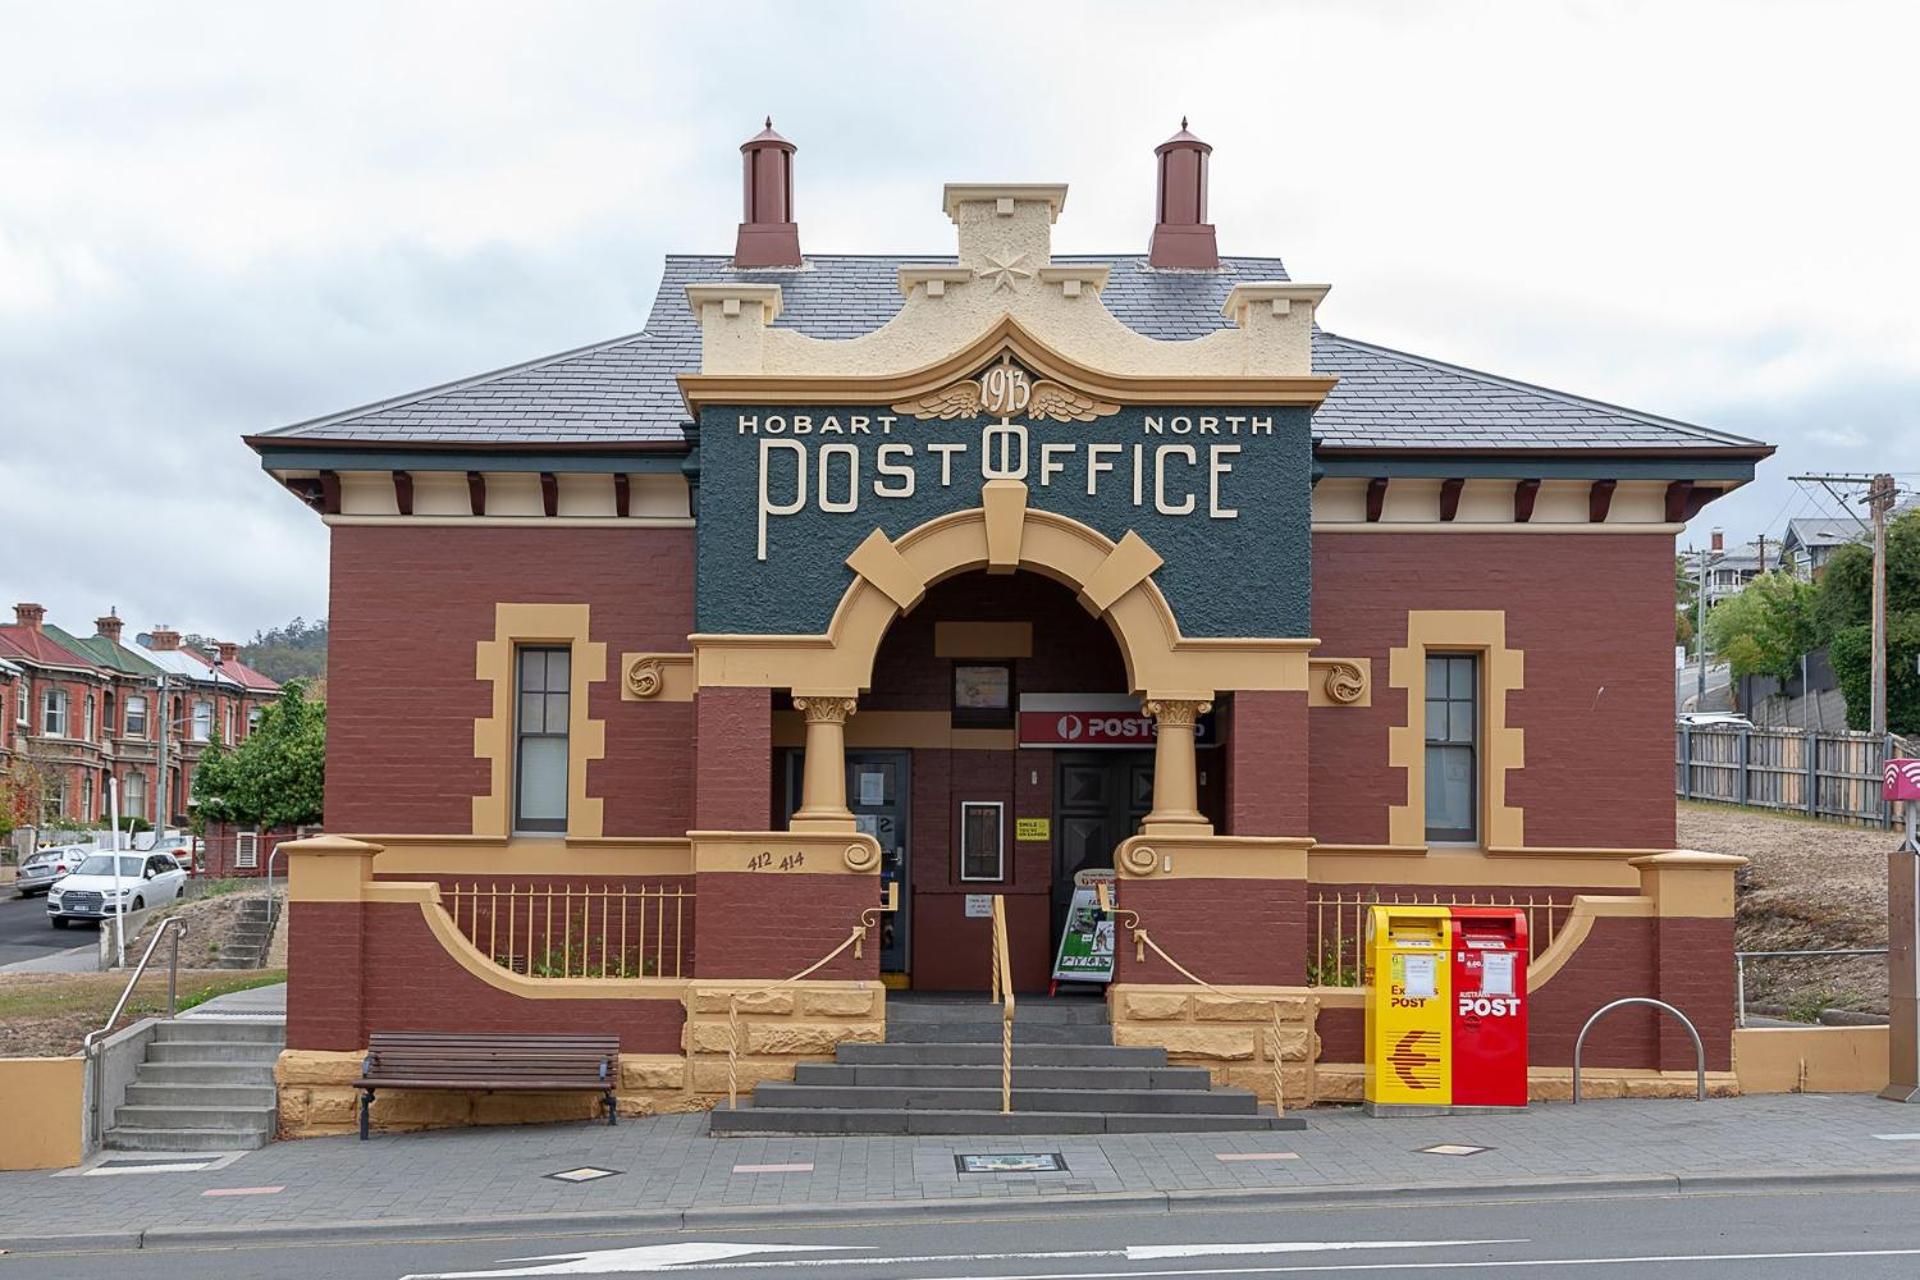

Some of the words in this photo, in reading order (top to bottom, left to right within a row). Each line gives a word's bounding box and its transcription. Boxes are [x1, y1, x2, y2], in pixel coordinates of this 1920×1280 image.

[980, 368, 1030, 412] 1913
[738, 415, 897, 435] HOBART
[1145, 416, 1273, 435] NORTH
[757, 438, 968, 561] POST
[981, 417, 1242, 518] OFFICE
[747, 851, 773, 871] 412
[778, 851, 804, 871] 414
[1391, 998, 1426, 1008] POST
[1459, 998, 1521, 1017] POST
